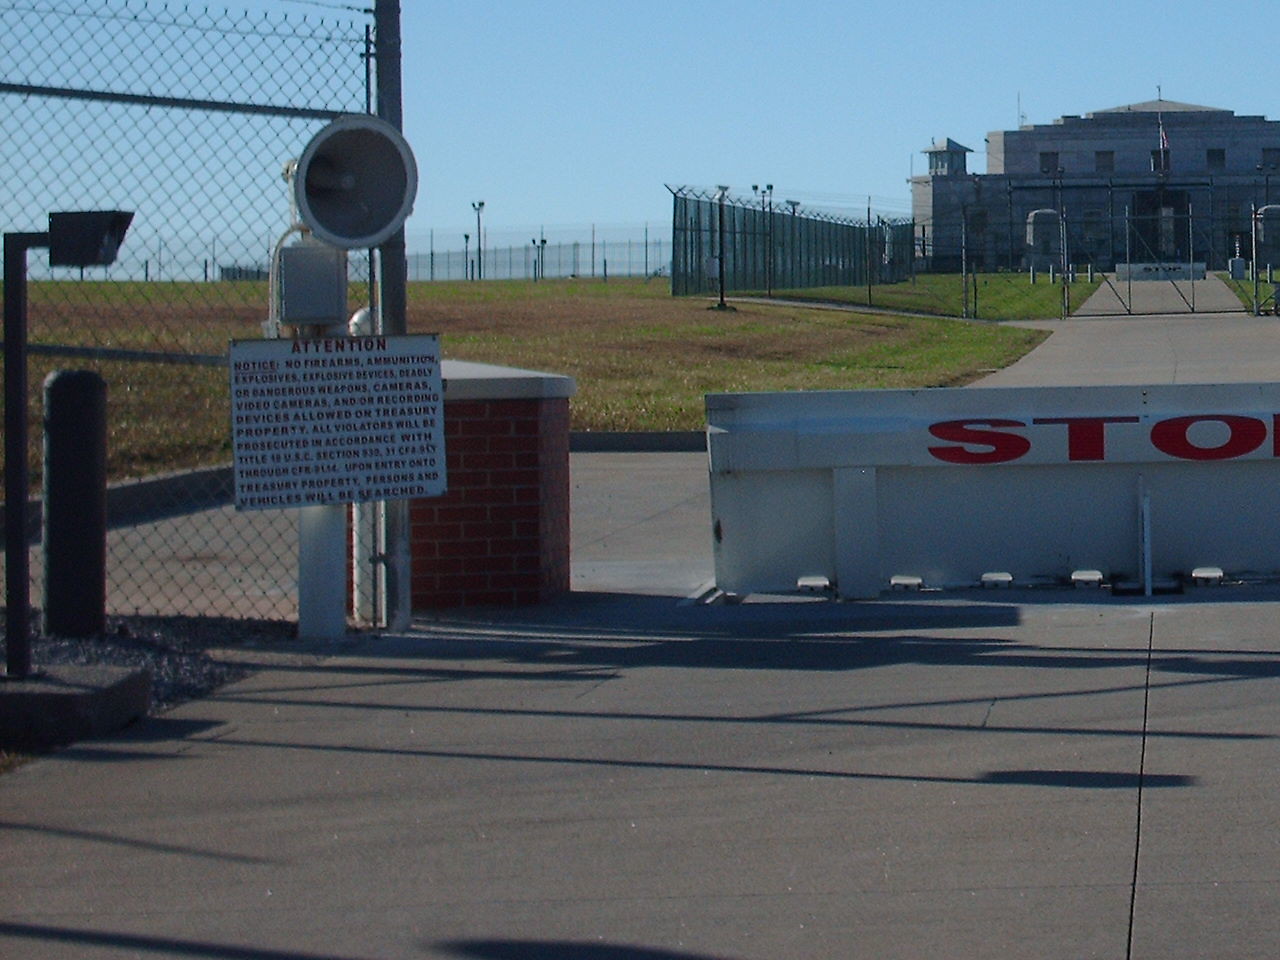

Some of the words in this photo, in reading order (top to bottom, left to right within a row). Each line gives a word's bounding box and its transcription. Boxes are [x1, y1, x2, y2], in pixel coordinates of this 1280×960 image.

[291, 338, 386, 354] ATTENTION
[285, 360, 301, 369] NO
[304, 357, 364, 369] FIREARMS,
[367, 355, 438, 366] AMMUNITION,
[303, 370, 353, 381] EXPLOSIVE
[399, 367, 432, 377] DEADLY
[235, 388, 250, 398] OR
[253, 385, 315, 397] DANGEROUS
[373, 381, 432, 392] CAMERAS,
[236, 401, 270, 411] VIDEO
[377, 393, 439, 404] RECORDING
[236, 413, 290, 424] DEVICES
[293, 409, 352, 421] ALLOWED
[355, 409, 372, 419] ON
[376, 405, 438, 417] TREASURY
[312, 424, 332, 434] ALL
[334, 420, 394, 432] VIOLATORS
[396, 419, 420, 428] WILL
[422, 418, 436, 428] BE
[237, 439, 310, 451] PROSECUTED
[312, 439, 323, 447] IN
[325, 434, 396, 447] ACCORDANCE
[401, 432, 433, 443] WITH
[240, 454, 268, 464] TITLE
[316, 448, 360, 460] SECTION
[240, 466, 289, 478] THROUGH
[345, 461, 373, 472] UPON
[375, 459, 406, 470] ENTRY
[409, 457, 436, 468] ONTO
[241, 481, 298, 493] TREASURY
[366, 473, 416, 485] PERSONS
[418, 471, 439, 481] AND
[241, 494, 302, 507] VEHICLES
[305, 491, 333, 501] WILL
[338, 490, 354, 499] BE
